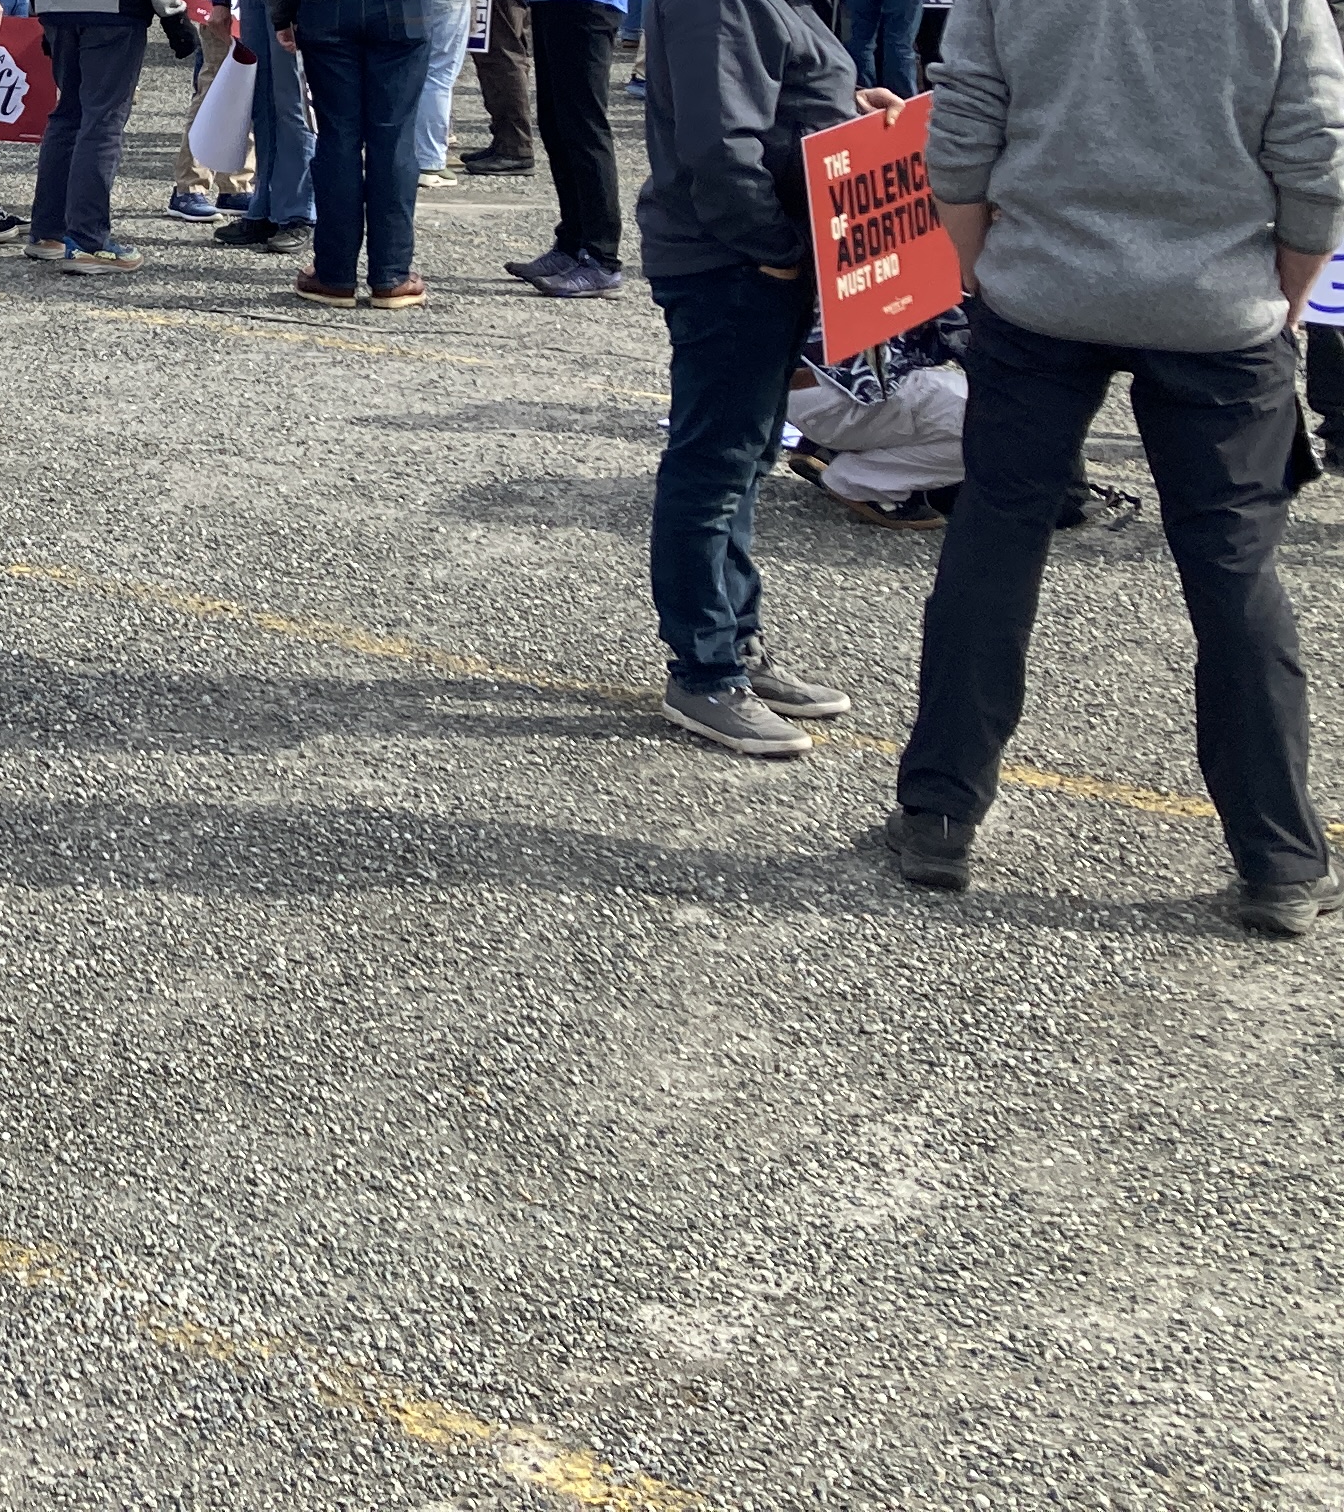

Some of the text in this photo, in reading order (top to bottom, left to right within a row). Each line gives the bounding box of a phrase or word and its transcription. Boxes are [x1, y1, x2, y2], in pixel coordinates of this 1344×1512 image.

[823, 149, 852, 180] THE
[829, 151, 931, 221] VIOLENC
[830, 213, 849, 241] OF
[837, 193, 942, 272] ABORTION
[836, 253, 901, 300] MUST END
